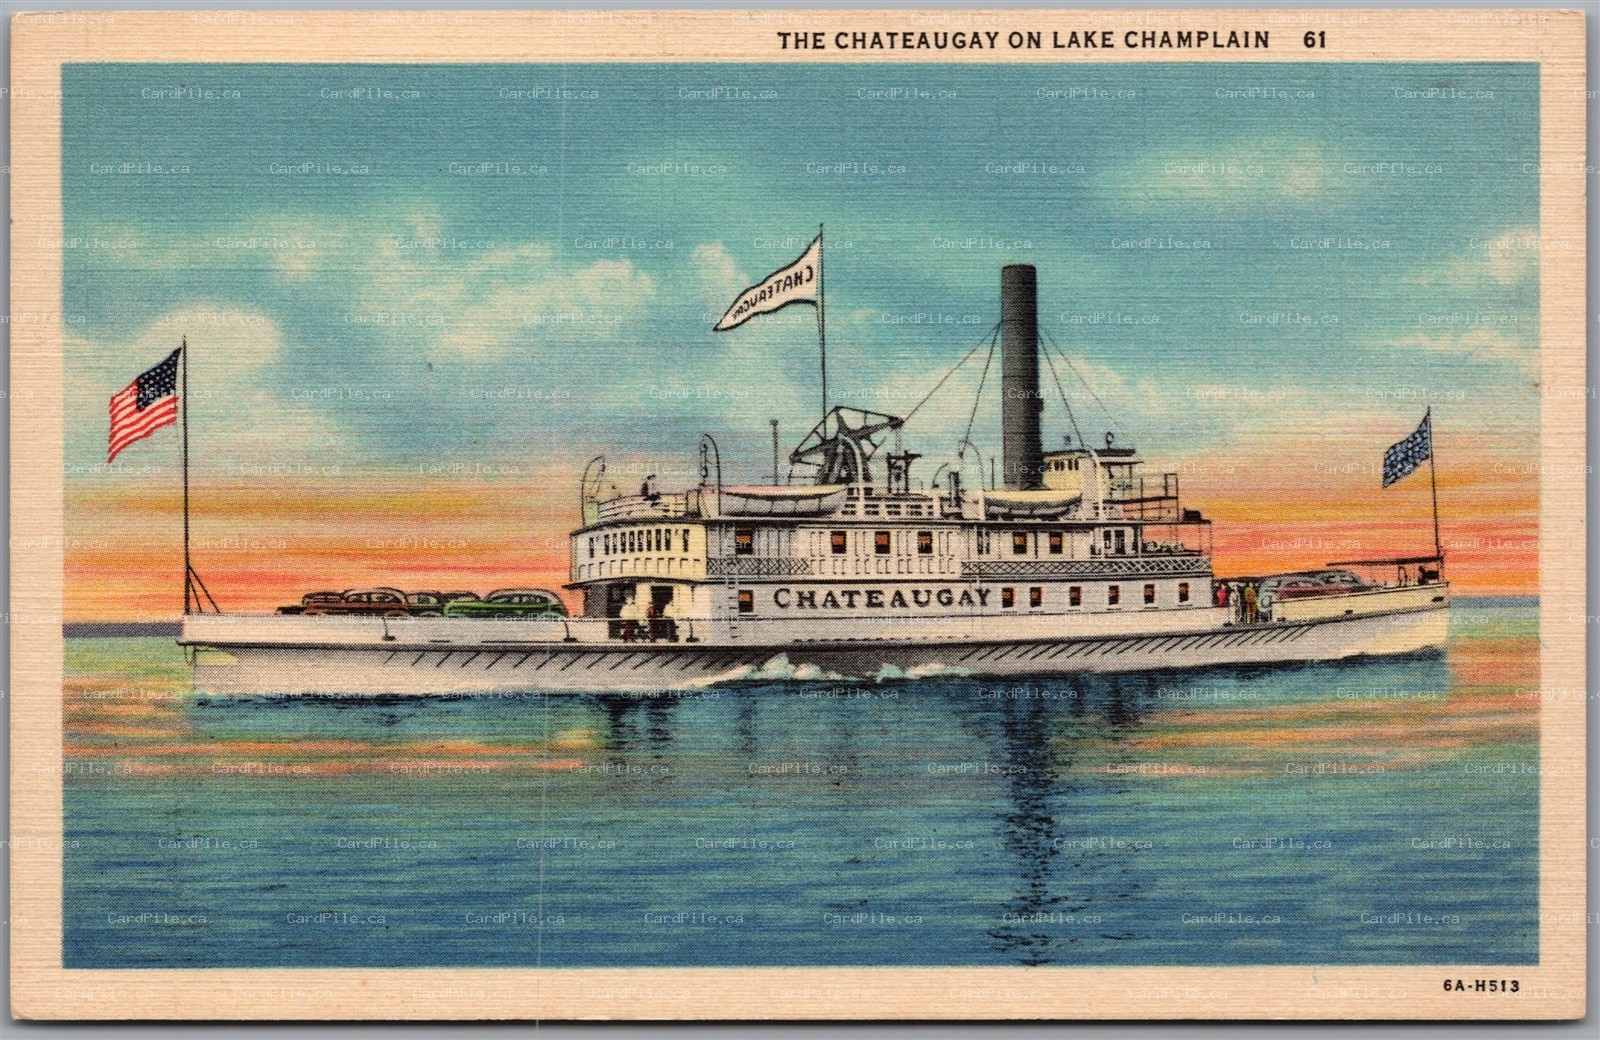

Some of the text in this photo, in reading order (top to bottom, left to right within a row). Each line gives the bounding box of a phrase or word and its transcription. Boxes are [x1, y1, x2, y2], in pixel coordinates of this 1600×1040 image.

[777, 31, 1325, 49] THE CHATEAUGAY ON LAKE CHAMPLAIN 61
[774, 589, 991, 609] CHATEAUGAY
[1444, 980, 1519, 992] 6A-H513
